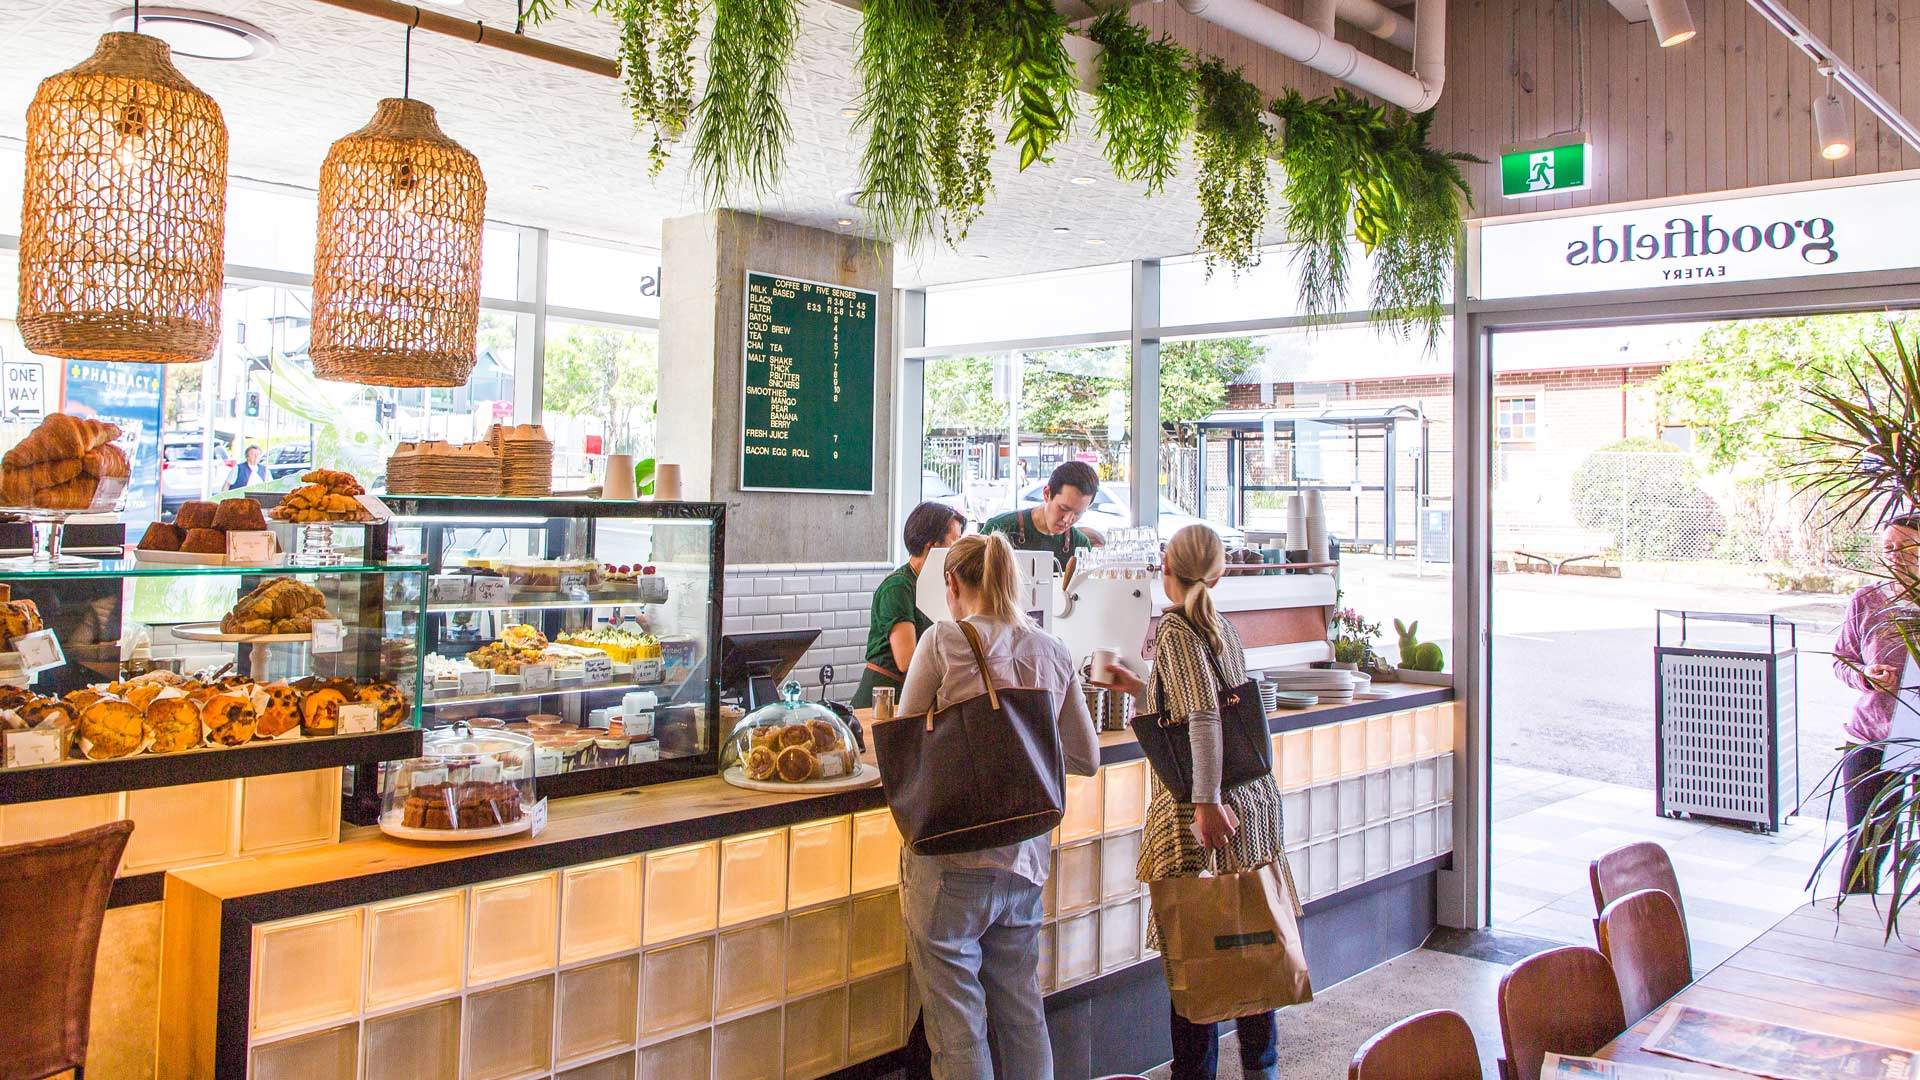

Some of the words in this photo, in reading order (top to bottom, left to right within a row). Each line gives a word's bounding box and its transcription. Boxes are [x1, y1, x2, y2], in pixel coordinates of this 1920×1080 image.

[750, 285, 767, 294] MILK
[773, 288, 795, 298] BASED
[775, 280, 800, 290] COFFEE
[803, 282, 812, 292] BY
[816, 286, 829, 295] FIVE
[832, 289, 856, 299] SENSES
[750, 294, 773, 304] BLACK
[749, 303, 771, 314] FILTER
[749, 313, 772, 323] BATCH
[749, 322, 768, 332] COLD
[771, 325, 791, 335] BREW
[834, 334, 838, 342] 4
[749, 332, 762, 340] TEA
[747, 340, 763, 350] CHAI
[770, 343, 782, 352] TEA
[748, 353, 766, 362] MALT
[769, 356, 792, 366] SHAKE
[770, 364, 790, 373] THICK
[9, 368, 37, 382] ONE
[82, 366, 150, 389] PHARMACY
[768, 379, 800, 389] SNICKERS
[9, 387, 37, 401] WAY
[747, 386, 787, 397] SMOOTHIES
[771, 397, 796, 406] MANGO
[771, 405, 788, 413] PEAR
[771, 412, 798, 421] BANANA
[771, 420, 791, 428] BERRY
[746, 429, 767, 438] FRESH
[769, 431, 788, 439] JUICE
[834, 435, 838, 443] 7
[746, 446, 769, 455] BACON
[773, 448, 786, 456] EGG
[792, 449, 809, 457] ROLL
